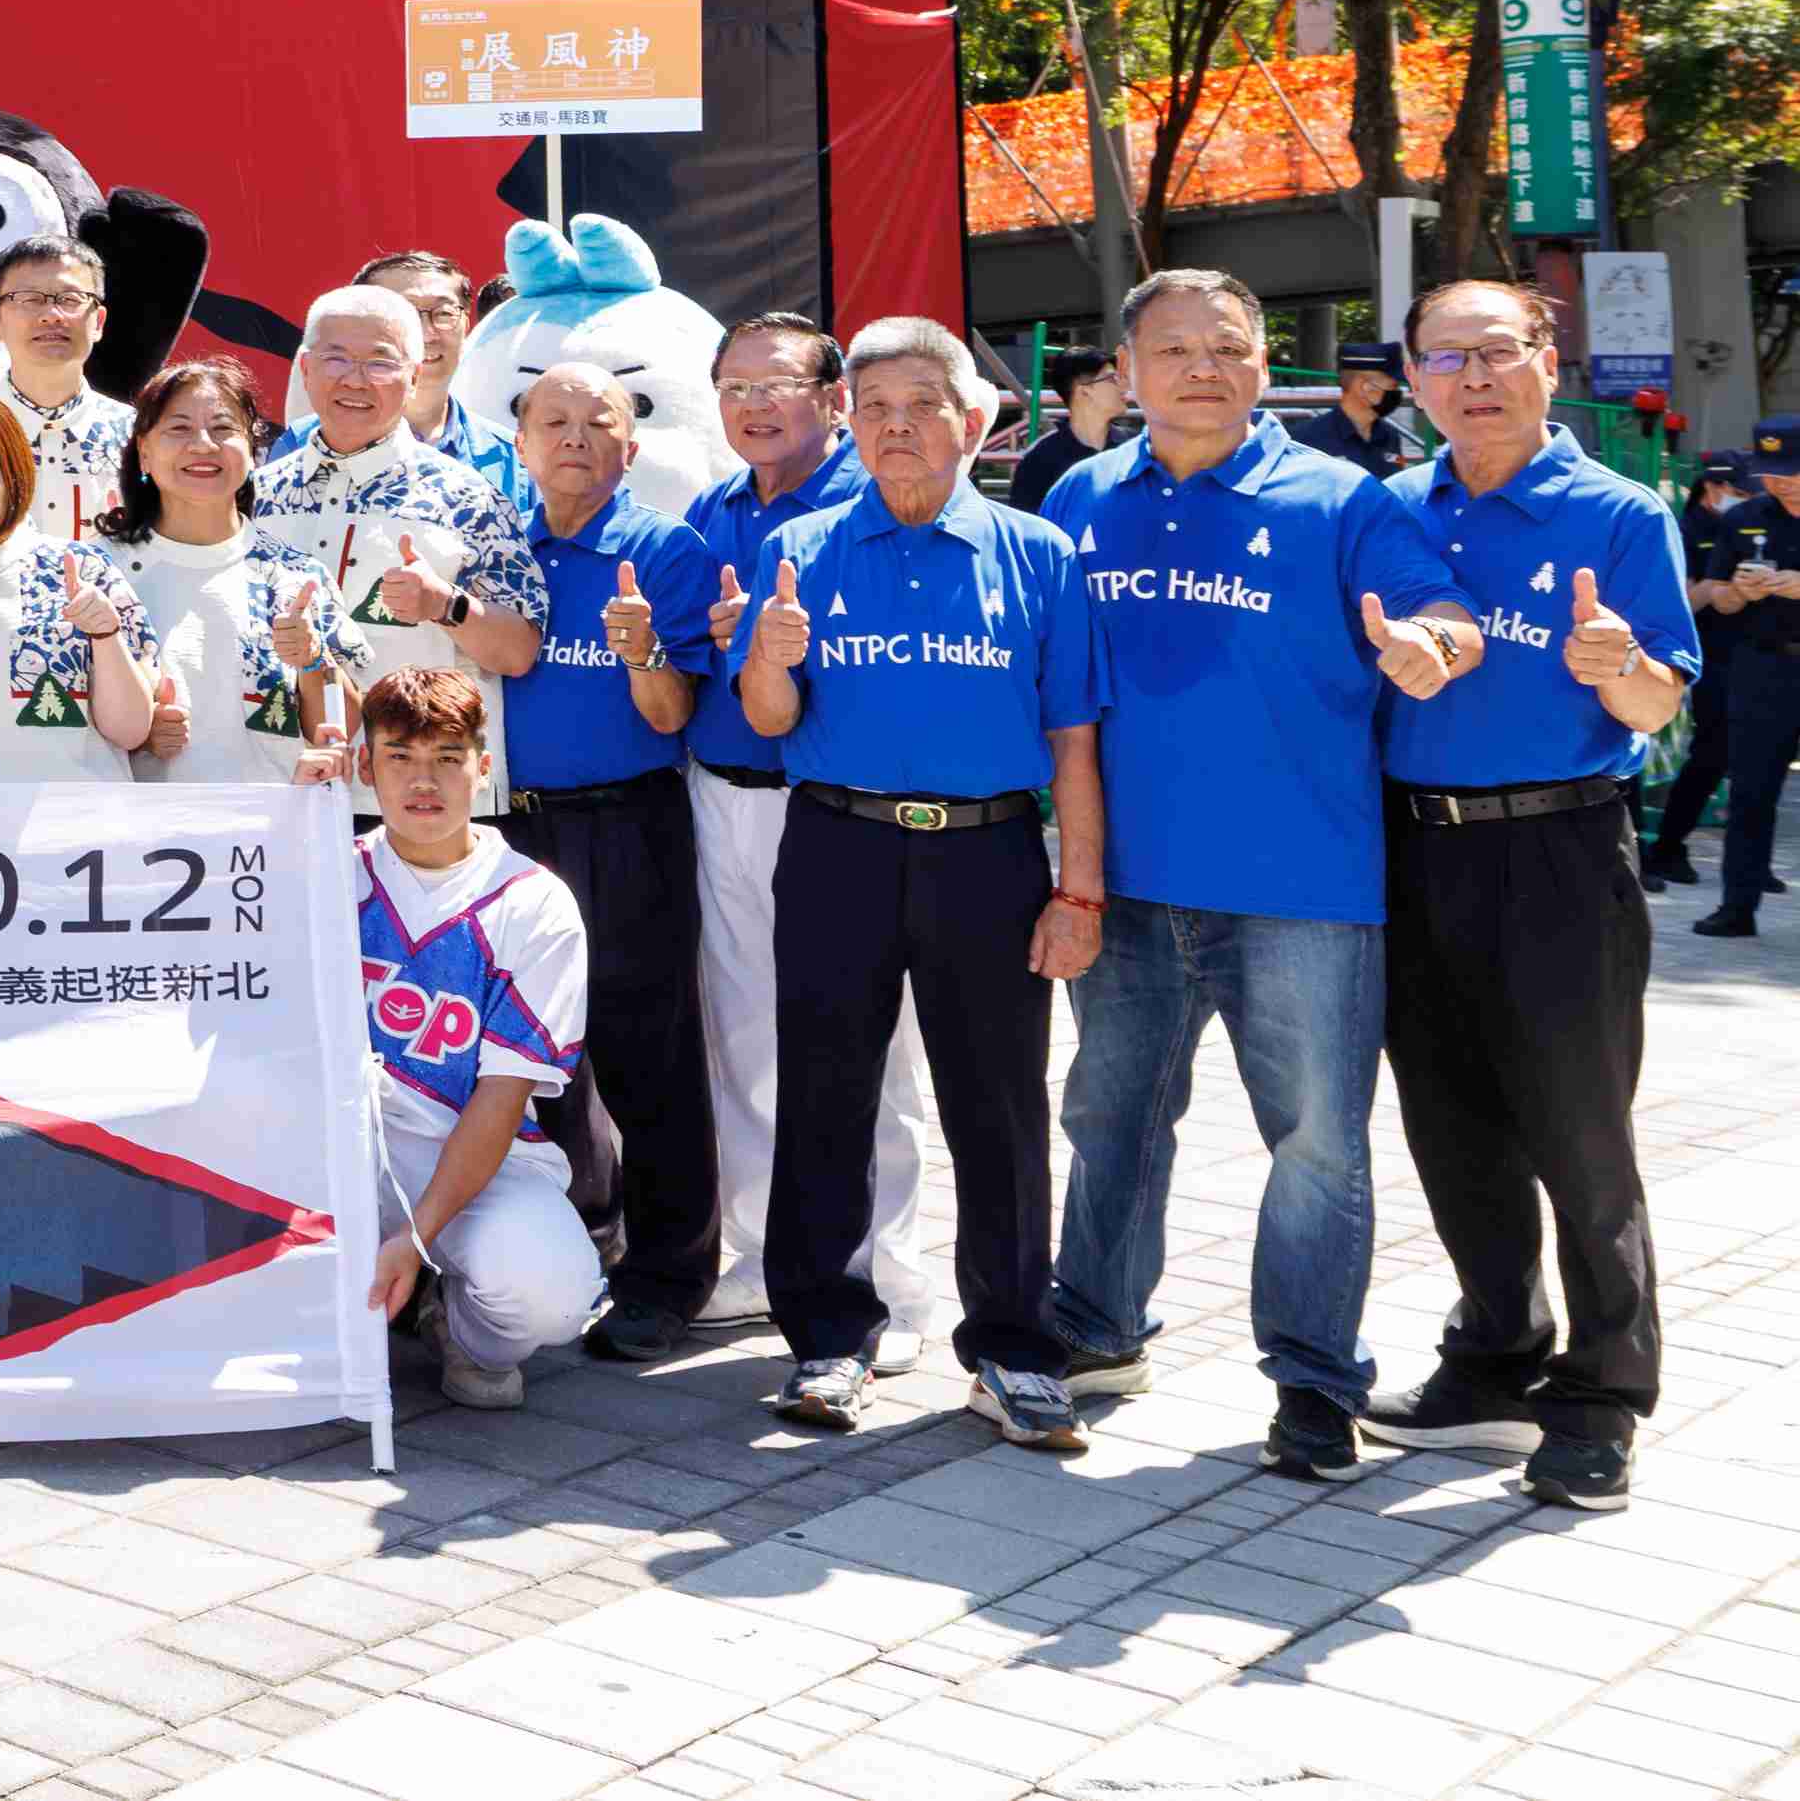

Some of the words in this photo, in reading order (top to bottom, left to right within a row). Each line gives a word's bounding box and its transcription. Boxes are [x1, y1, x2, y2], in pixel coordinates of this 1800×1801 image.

[477, 26, 651, 72] 展風神
[497, 108, 609, 128] 交通局-馬路寶
[1086, 568, 1157, 602] TPC
[1167, 567, 1273, 614] Hakka
[820, 634, 912, 668] NTPC
[921, 631, 1013, 670] Hakka
[230, 845, 265, 933] MON
